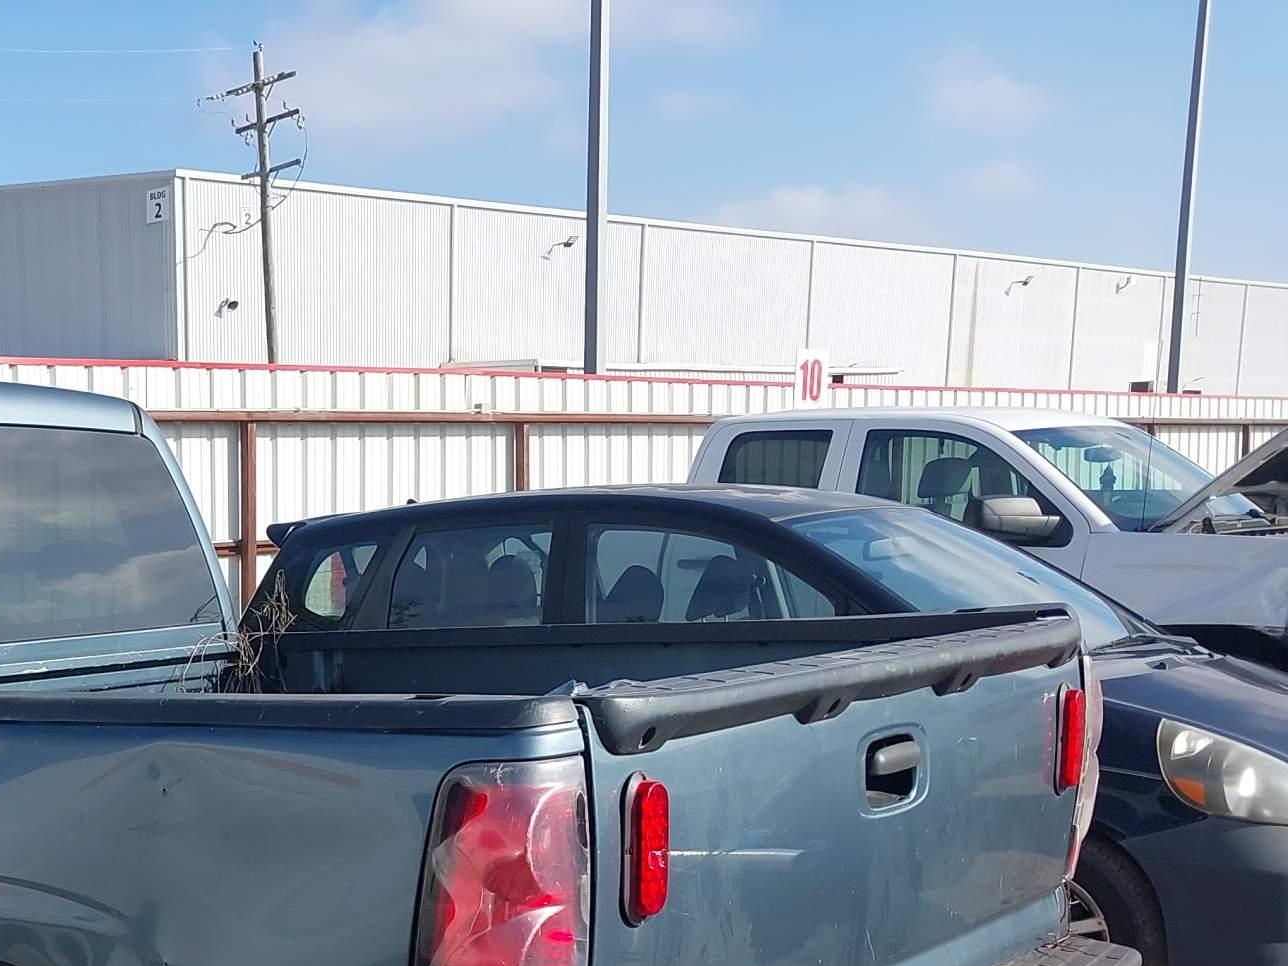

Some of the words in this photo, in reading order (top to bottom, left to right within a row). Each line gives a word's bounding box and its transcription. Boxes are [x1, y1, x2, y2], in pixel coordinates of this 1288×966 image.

[150, 190, 166, 201] BLDG
[154, 203, 163, 219] 2
[244, 213, 251, 225] 2
[800, 359, 822, 401] 10
